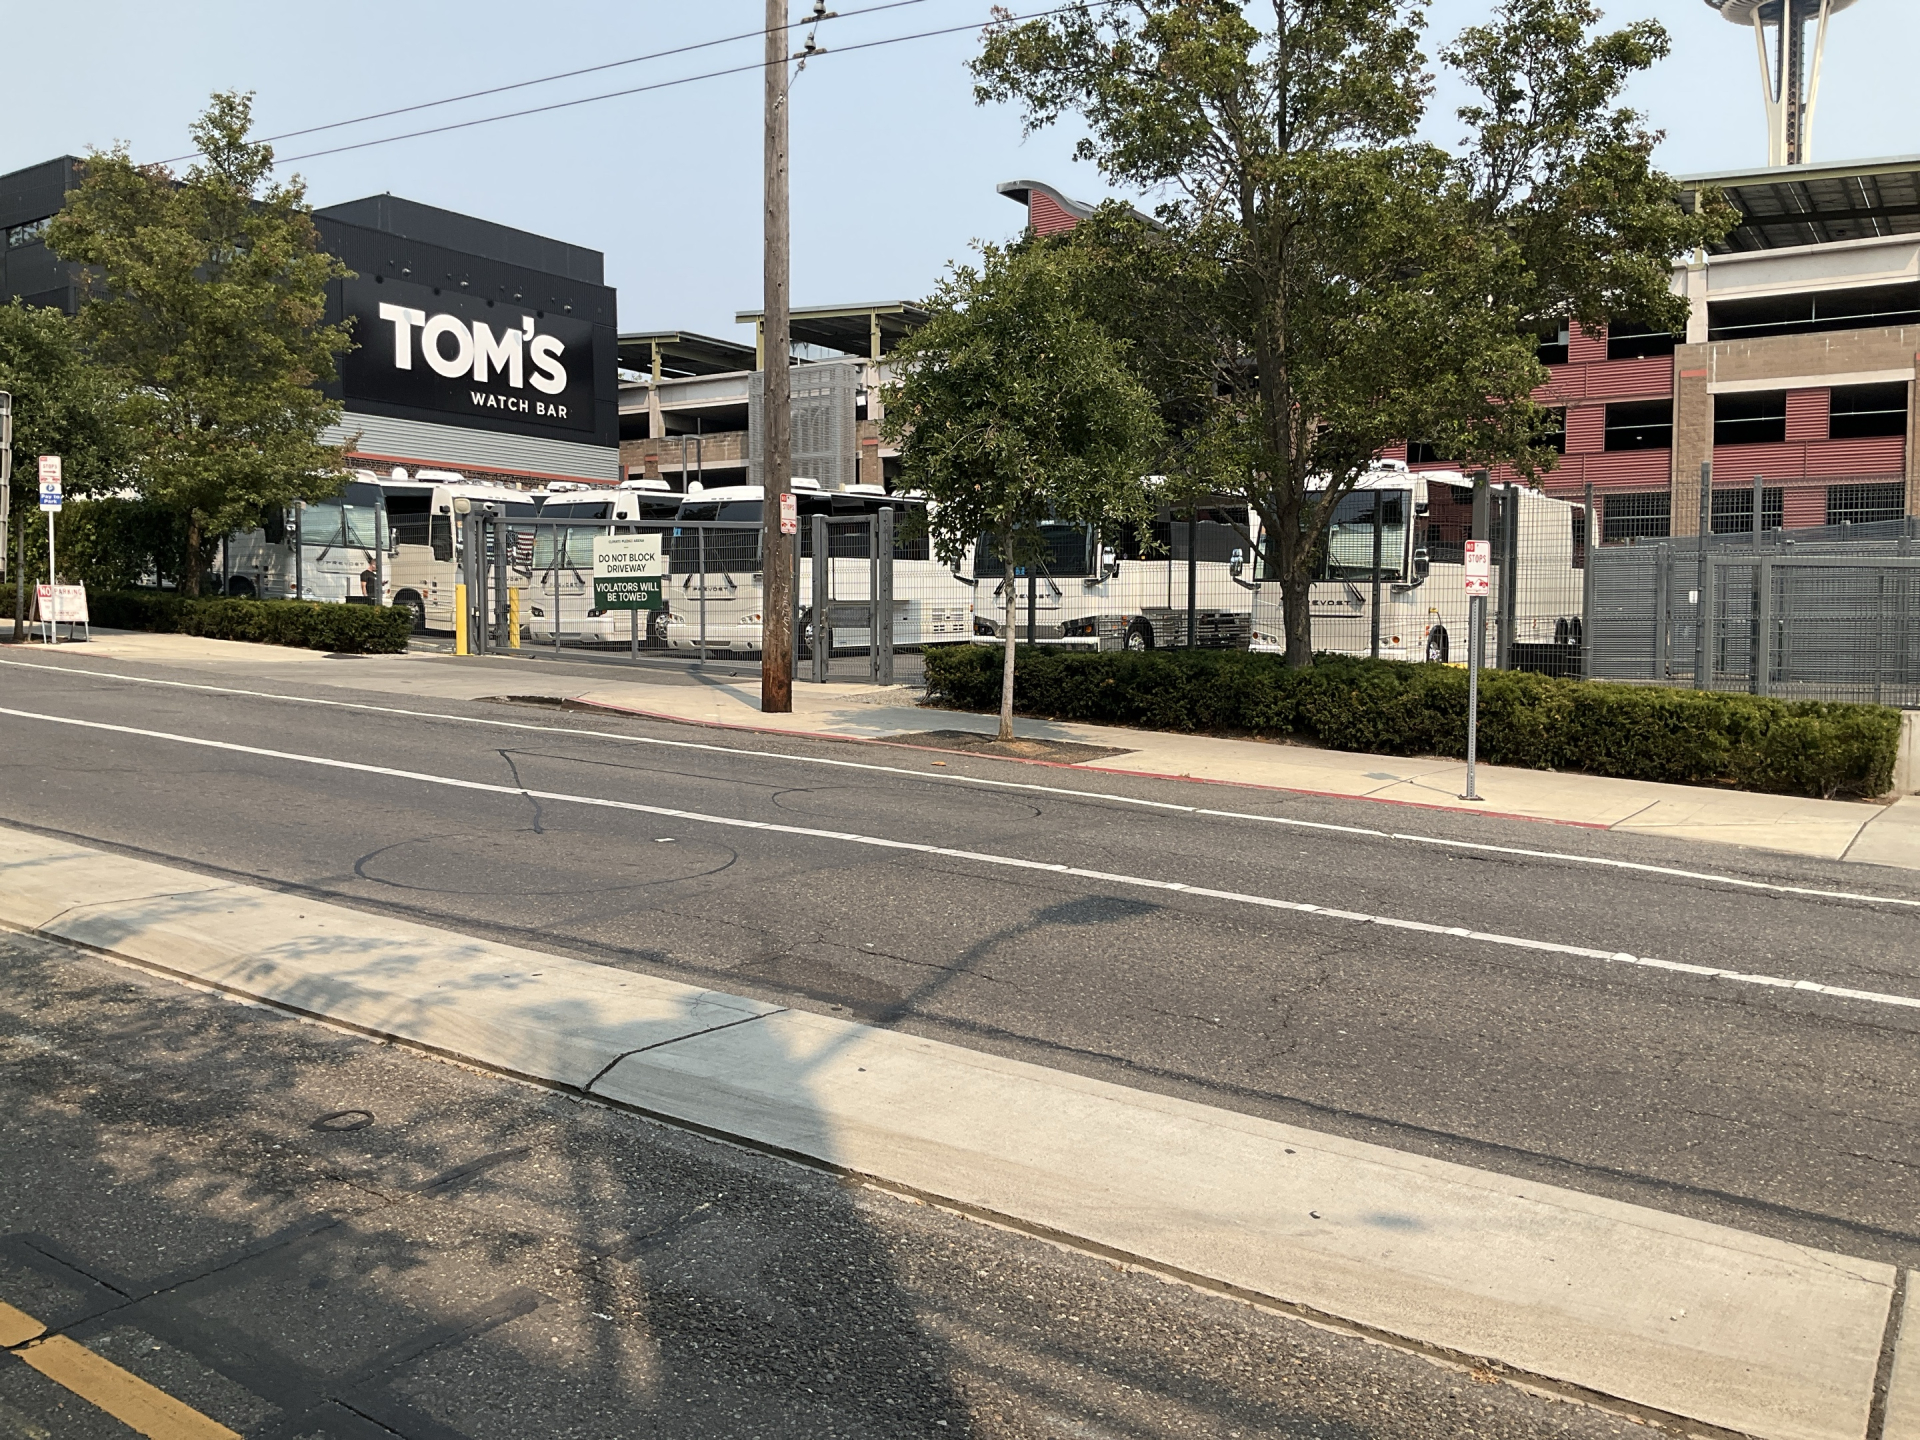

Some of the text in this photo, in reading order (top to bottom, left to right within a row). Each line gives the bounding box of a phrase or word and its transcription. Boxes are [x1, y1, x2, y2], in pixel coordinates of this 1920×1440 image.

[379, 302, 567, 395] TOM'S
[470, 390, 567, 419] WATCH BAR
[598, 552, 655, 563] DO NOT BLOCK
[1468, 554, 1487, 564] STOPS
[607, 563, 646, 573] DRIVEWAY
[40, 587, 51, 596] NO
[596, 581, 659, 592] VIOLATORS WILL
[607, 592, 648, 602] BE TOWED
